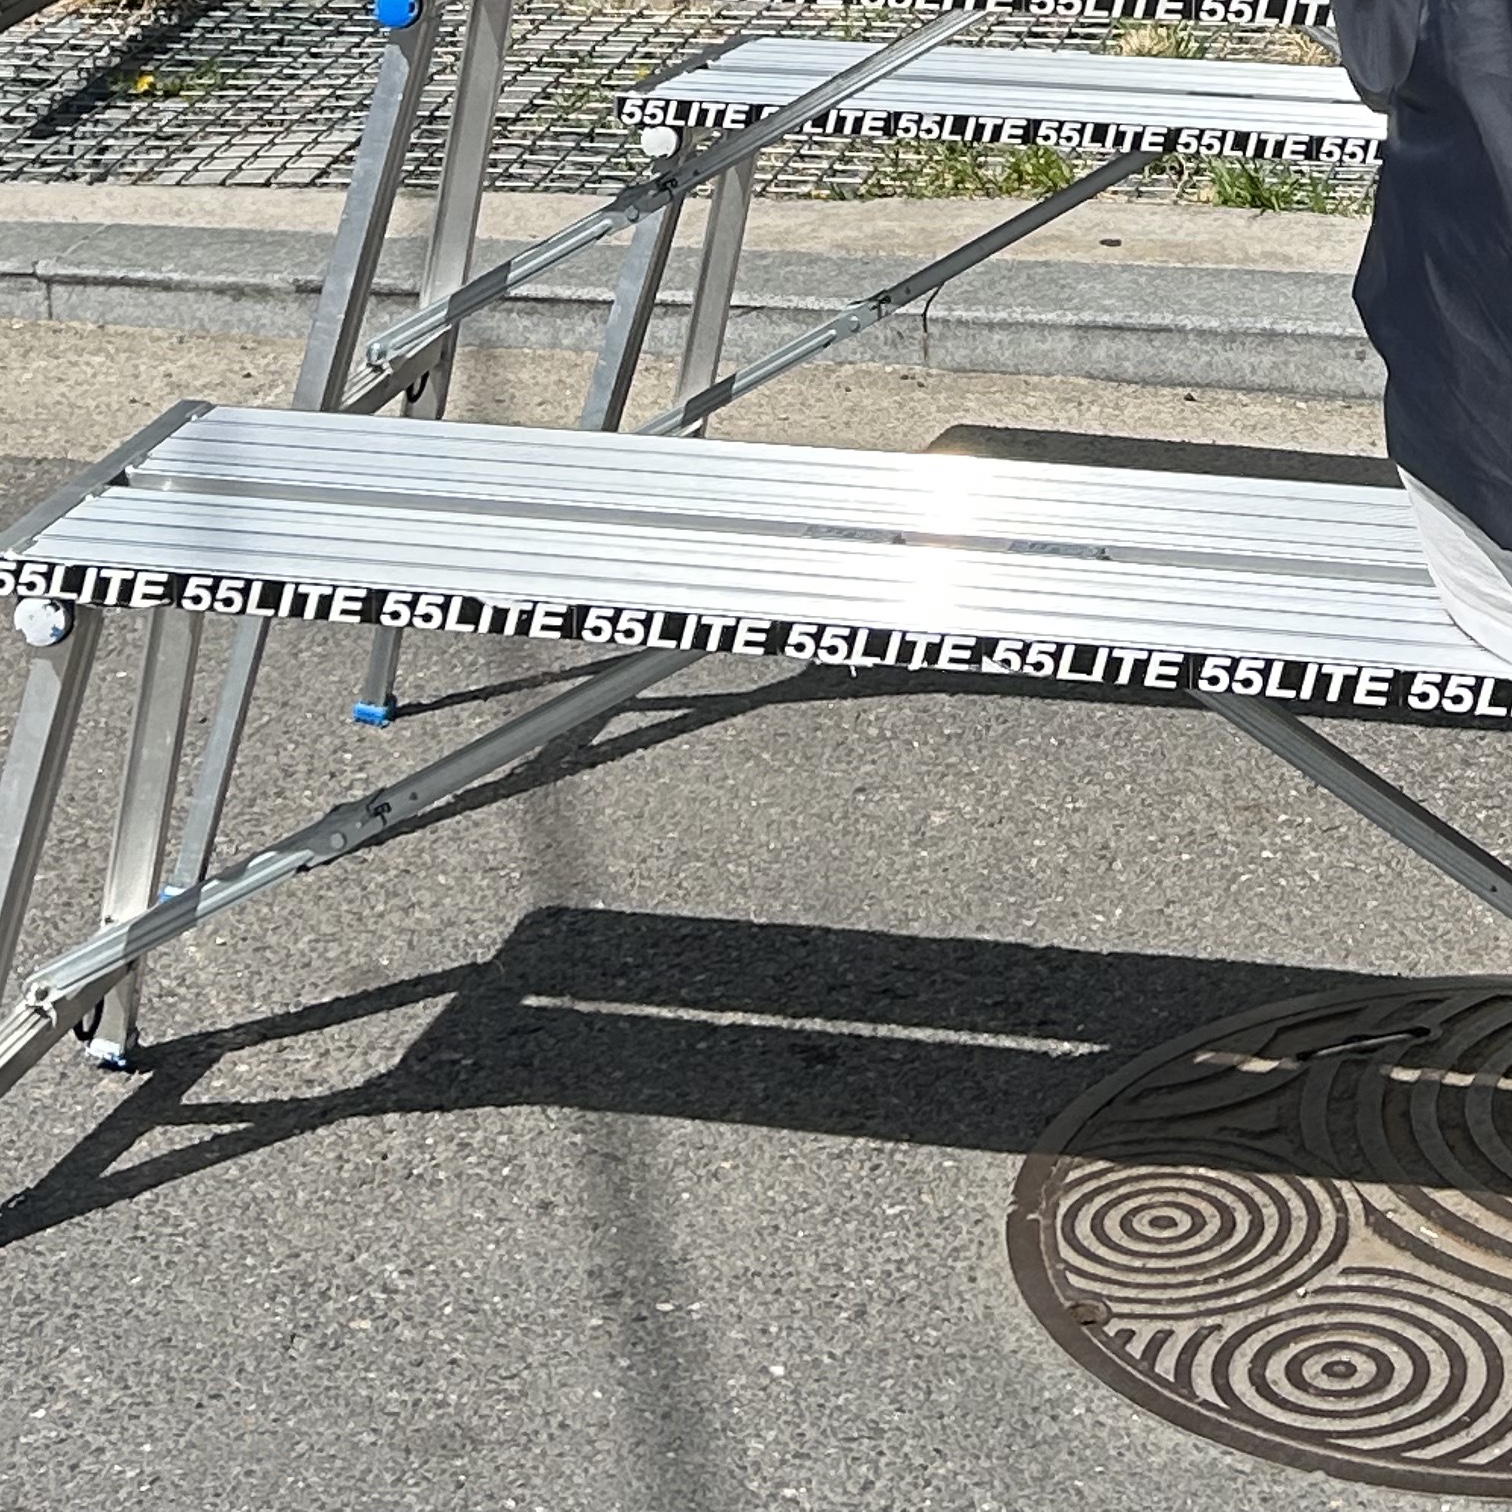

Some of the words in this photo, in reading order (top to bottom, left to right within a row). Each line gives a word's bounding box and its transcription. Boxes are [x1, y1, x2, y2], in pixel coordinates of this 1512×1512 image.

[621, 98, 749, 129] 55LITE
[760, 106, 889, 137] LITE
[898, 113, 1027, 144] 55LITE
[1035, 121, 1167, 152] 55LITE
[1176, 129, 1310, 161] 55LITE
[1319, 137, 1383, 165] 55L
[182, 576, 367, 624] 55LITE
[380, 592, 568, 639] 55LITE
[581, 606, 771, 655] 55LITE
[785, 623, 978, 671] 55LITE
[986, 639, 1185, 689] 55LITE
[1199, 656, 1395, 708] 55LITE
